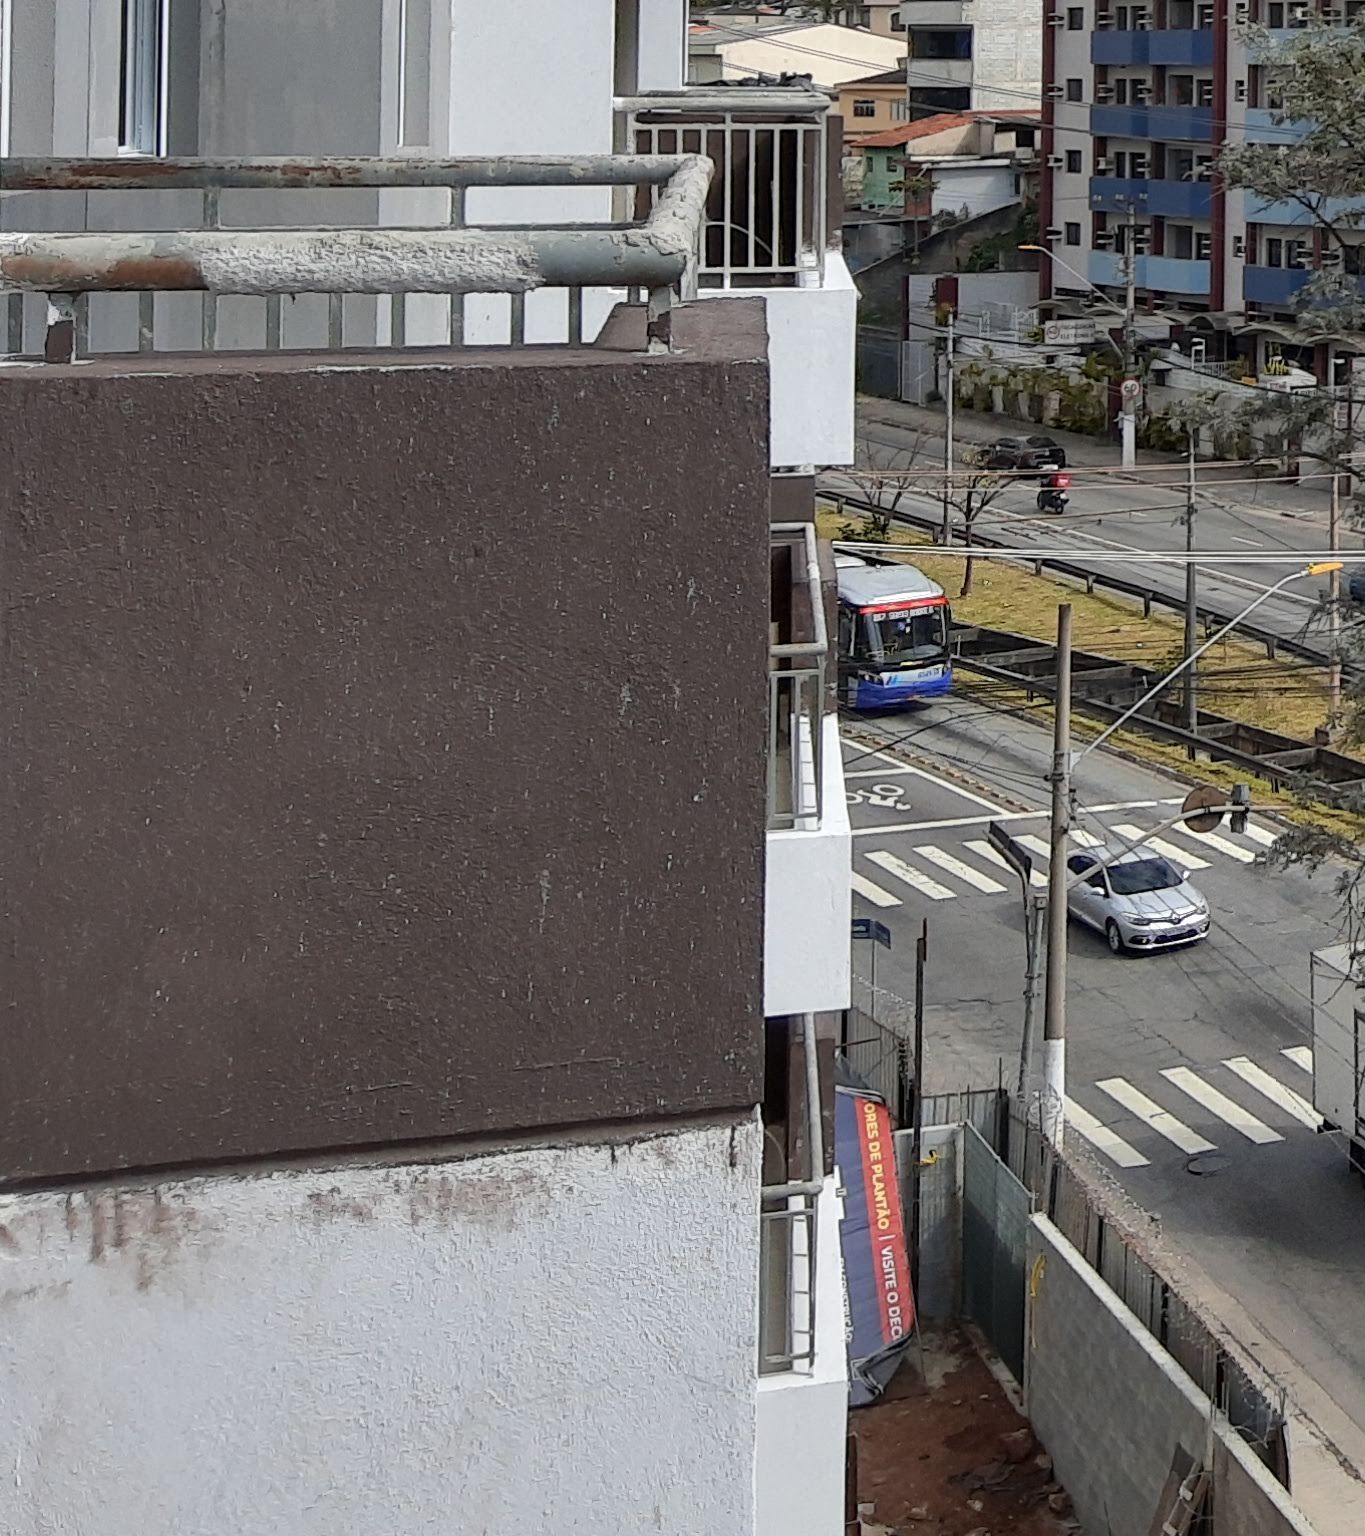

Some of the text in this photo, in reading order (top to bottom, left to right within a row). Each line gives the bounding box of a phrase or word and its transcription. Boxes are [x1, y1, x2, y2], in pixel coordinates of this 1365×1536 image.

[868, 1141, 882, 1162] DE
[871, 1164, 892, 1231] PLANTÃO
[881, 1245, 897, 1290] VISITE
[886, 1291, 899, 1304] O
[888, 1306, 903, 1341] DEC
